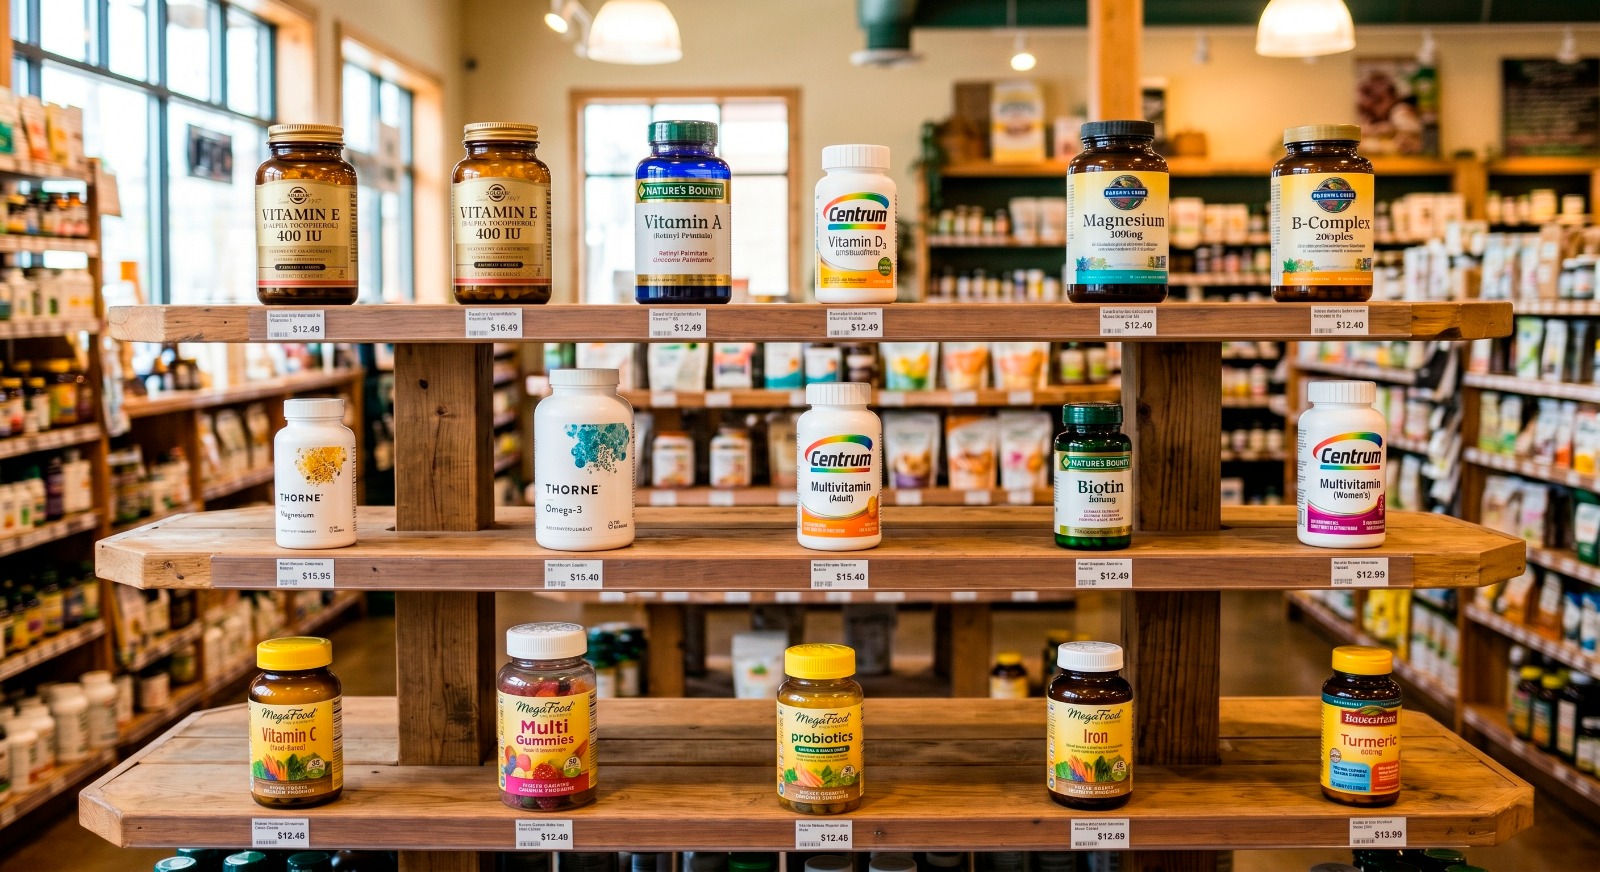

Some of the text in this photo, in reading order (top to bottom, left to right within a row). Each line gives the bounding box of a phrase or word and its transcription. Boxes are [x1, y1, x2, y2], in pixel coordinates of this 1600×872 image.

[646, 186, 722, 195] NATURE'S BOUNTY
[262, 209, 339, 220] VITAMIN E
[460, 206, 537, 218] VITAMIN E
[829, 207, 887, 222] Centrum
[645, 215, 722, 229] Vitamin A
[1083, 213, 1164, 230] Magnesium
[1292, 216, 1370, 232] B-Complex
[277, 230, 322, 241] 400 IU
[476, 228, 521, 239] 400 IU
[829, 236, 871, 247] Vitamin
[674, 324, 702, 332] $12.49
[1337, 321, 1364, 329] $12.40
[811, 451, 871, 466] Centrum
[1322, 448, 1381, 463] Centrum
[1072, 459, 1104, 467] NATURE'S
[546, 484, 598, 494] THORNE
[812, 482, 871, 492] Multivitamin
[1078, 480, 1124, 493] Biotin
[1320, 479, 1380, 489] Multivitamin
[830, 495, 853, 503] (Adult)
[1334, 492, 1370, 500] (Women's)
[546, 504, 582, 516] Omega-3
[302, 572, 330, 580] $15.95
[836, 573, 864, 581] $15.40
[1100, 572, 1129, 580] $12.49
[516, 701, 573, 717] MegaFood
[262, 708, 316, 724] MegaFood
[795, 712, 849, 728] MegaFood
[1068, 708, 1121, 724] MegaFood
[521, 719, 568, 734] Multi
[262, 727, 316, 743] Vitamin C
[516, 735, 574, 745] Gummies
[792, 732, 853, 743] probiotics
[1084, 729, 1108, 743] Iron
[1341, 734, 1396, 747] Turmeric
